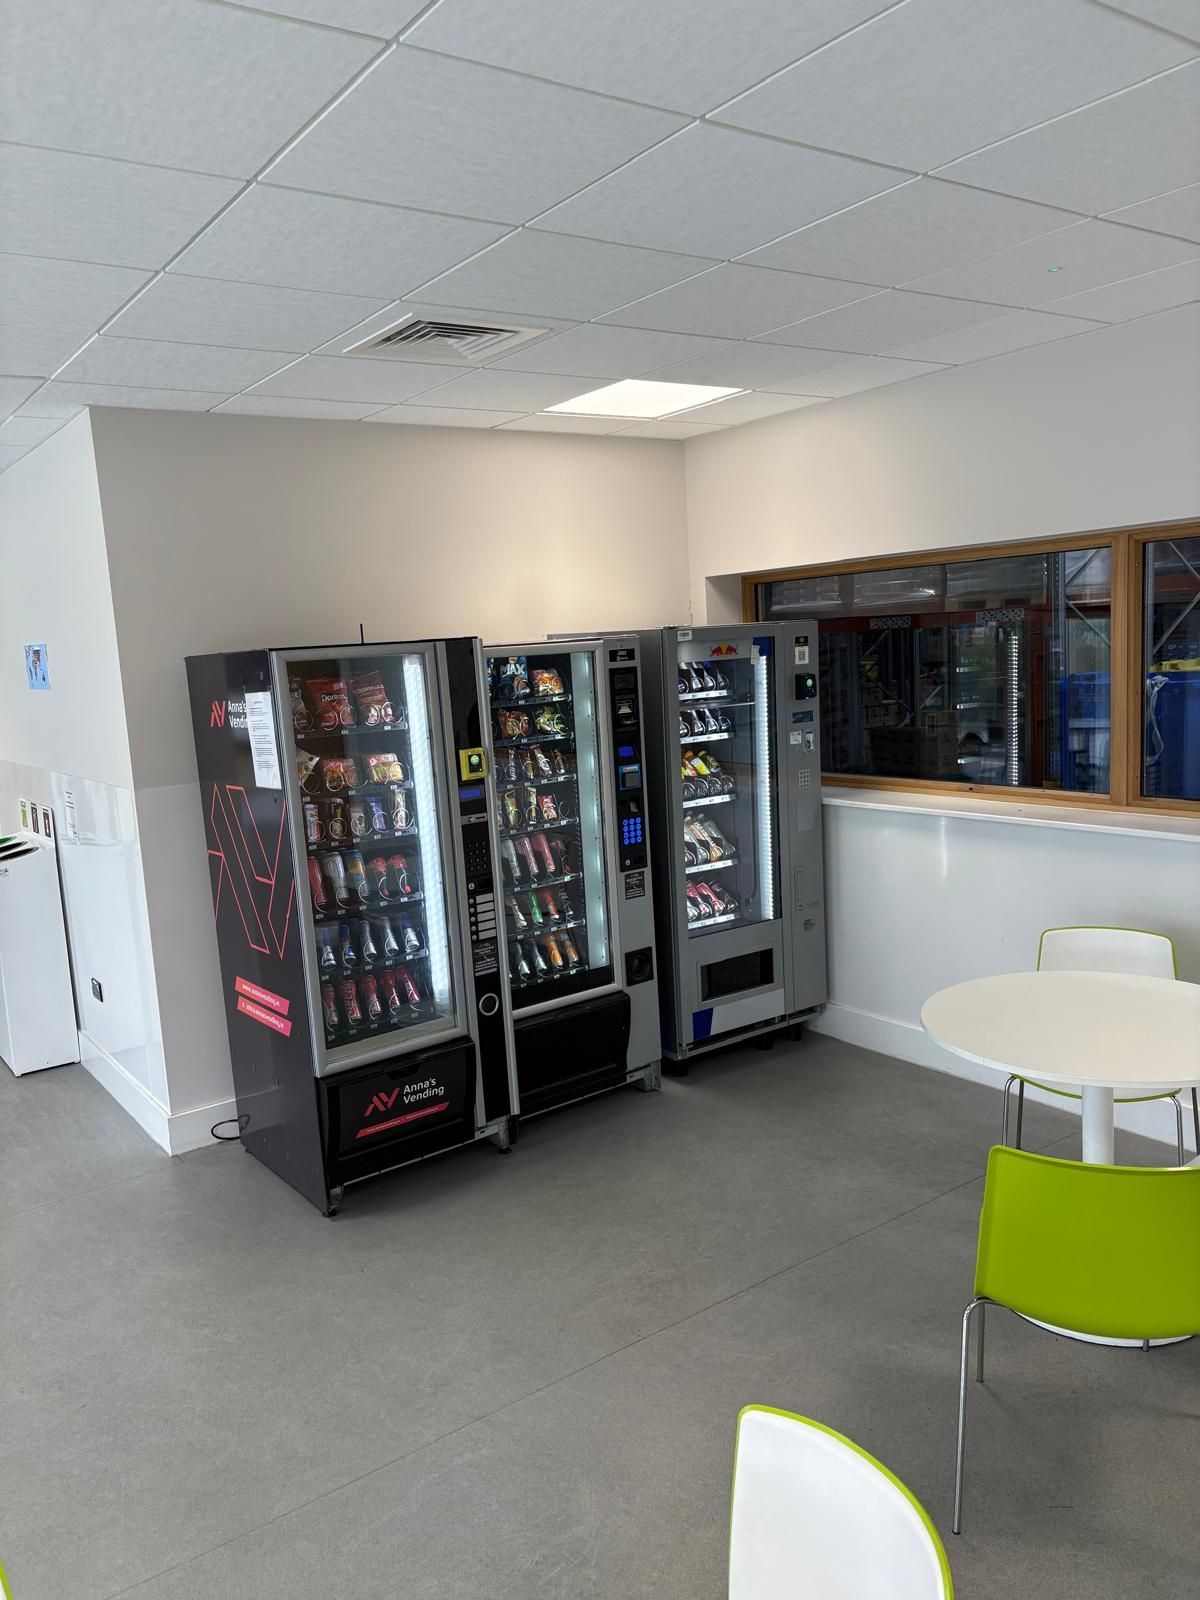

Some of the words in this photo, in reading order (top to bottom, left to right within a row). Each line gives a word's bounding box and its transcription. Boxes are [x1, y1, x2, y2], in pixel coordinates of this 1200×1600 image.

[500, 663, 526, 677] MAX
[228, 700, 247, 713] Anna's
[229, 714, 248, 728] Vendi
[403, 1078, 437, 1095] Anna's
[403, 1086, 445, 1104] Vending
